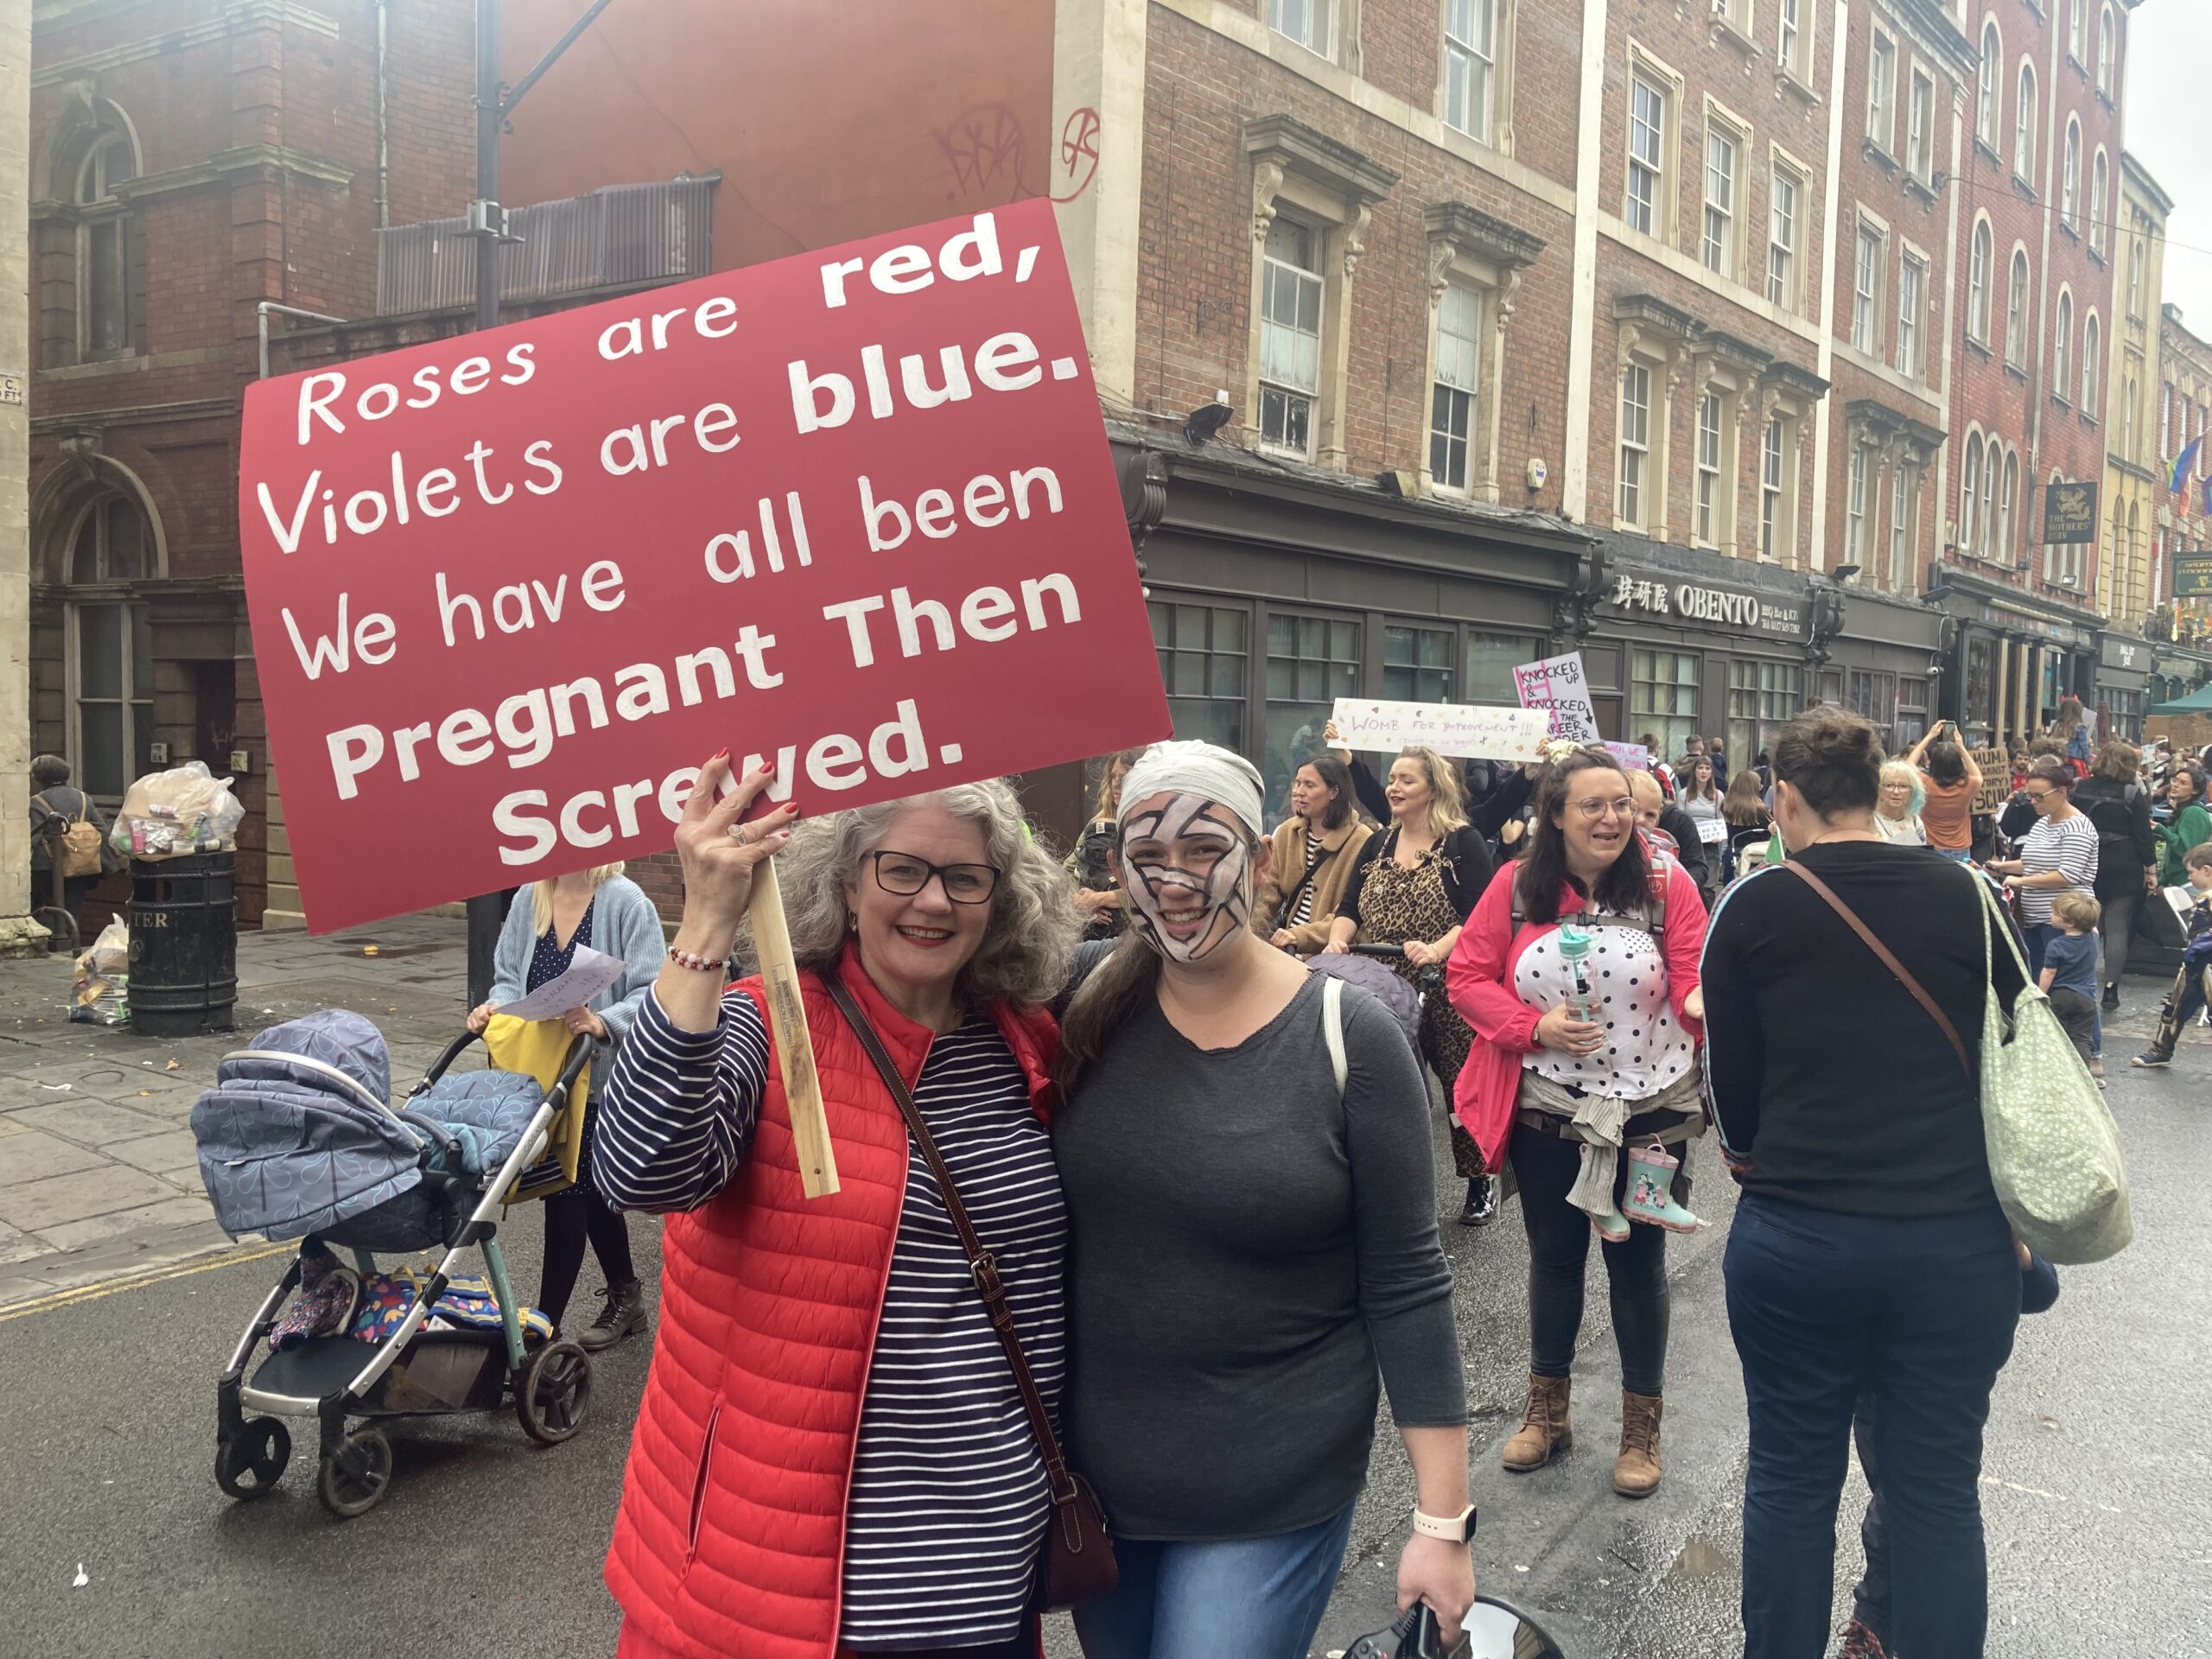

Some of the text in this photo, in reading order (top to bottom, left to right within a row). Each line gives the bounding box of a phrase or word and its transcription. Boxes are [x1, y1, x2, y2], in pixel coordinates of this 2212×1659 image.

[298, 212, 1040, 445] Roses are red,
[257, 333, 1078, 554] Violets are blue.
[282, 467, 1063, 680] We have all been
[1674, 585, 1758, 626] OBENTO
[327, 574, 1081, 799] Pregnant Then
[1521, 662, 1578, 684] KNOCKED
[1566, 673, 1580, 684] UP
[1527, 684, 1536, 697] &
[1528, 698, 1586, 711] KNOCKED
[1352, 716, 1400, 731] WOMB
[1413, 721, 1436, 730] FOR
[493, 699, 962, 865] Screwed.
[1982, 766, 2005, 776] GAINST
